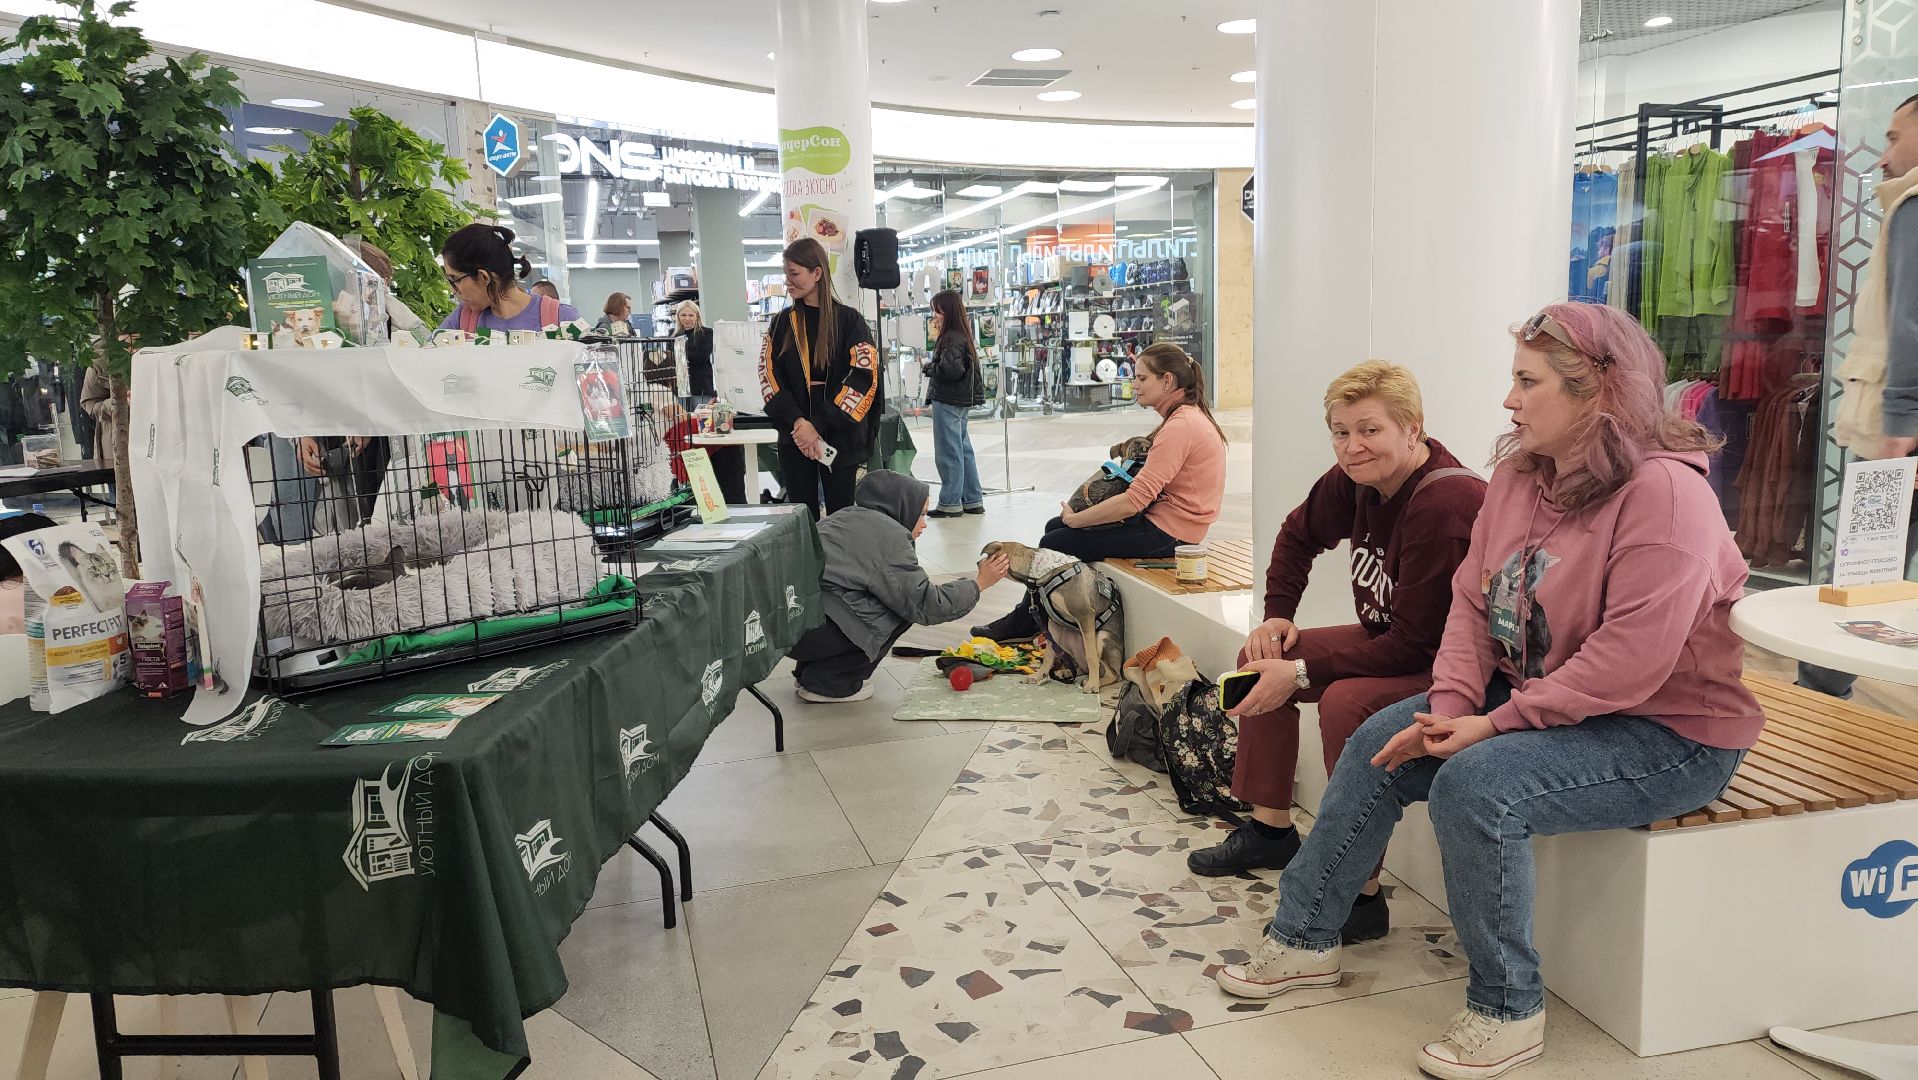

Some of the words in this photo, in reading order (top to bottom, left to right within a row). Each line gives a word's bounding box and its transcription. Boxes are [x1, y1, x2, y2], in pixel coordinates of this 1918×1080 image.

[52, 617, 109, 641] PERFECT
[413, 751, 443, 786] ДОМ
[410, 791, 436, 876] УЮТНЫЙ
